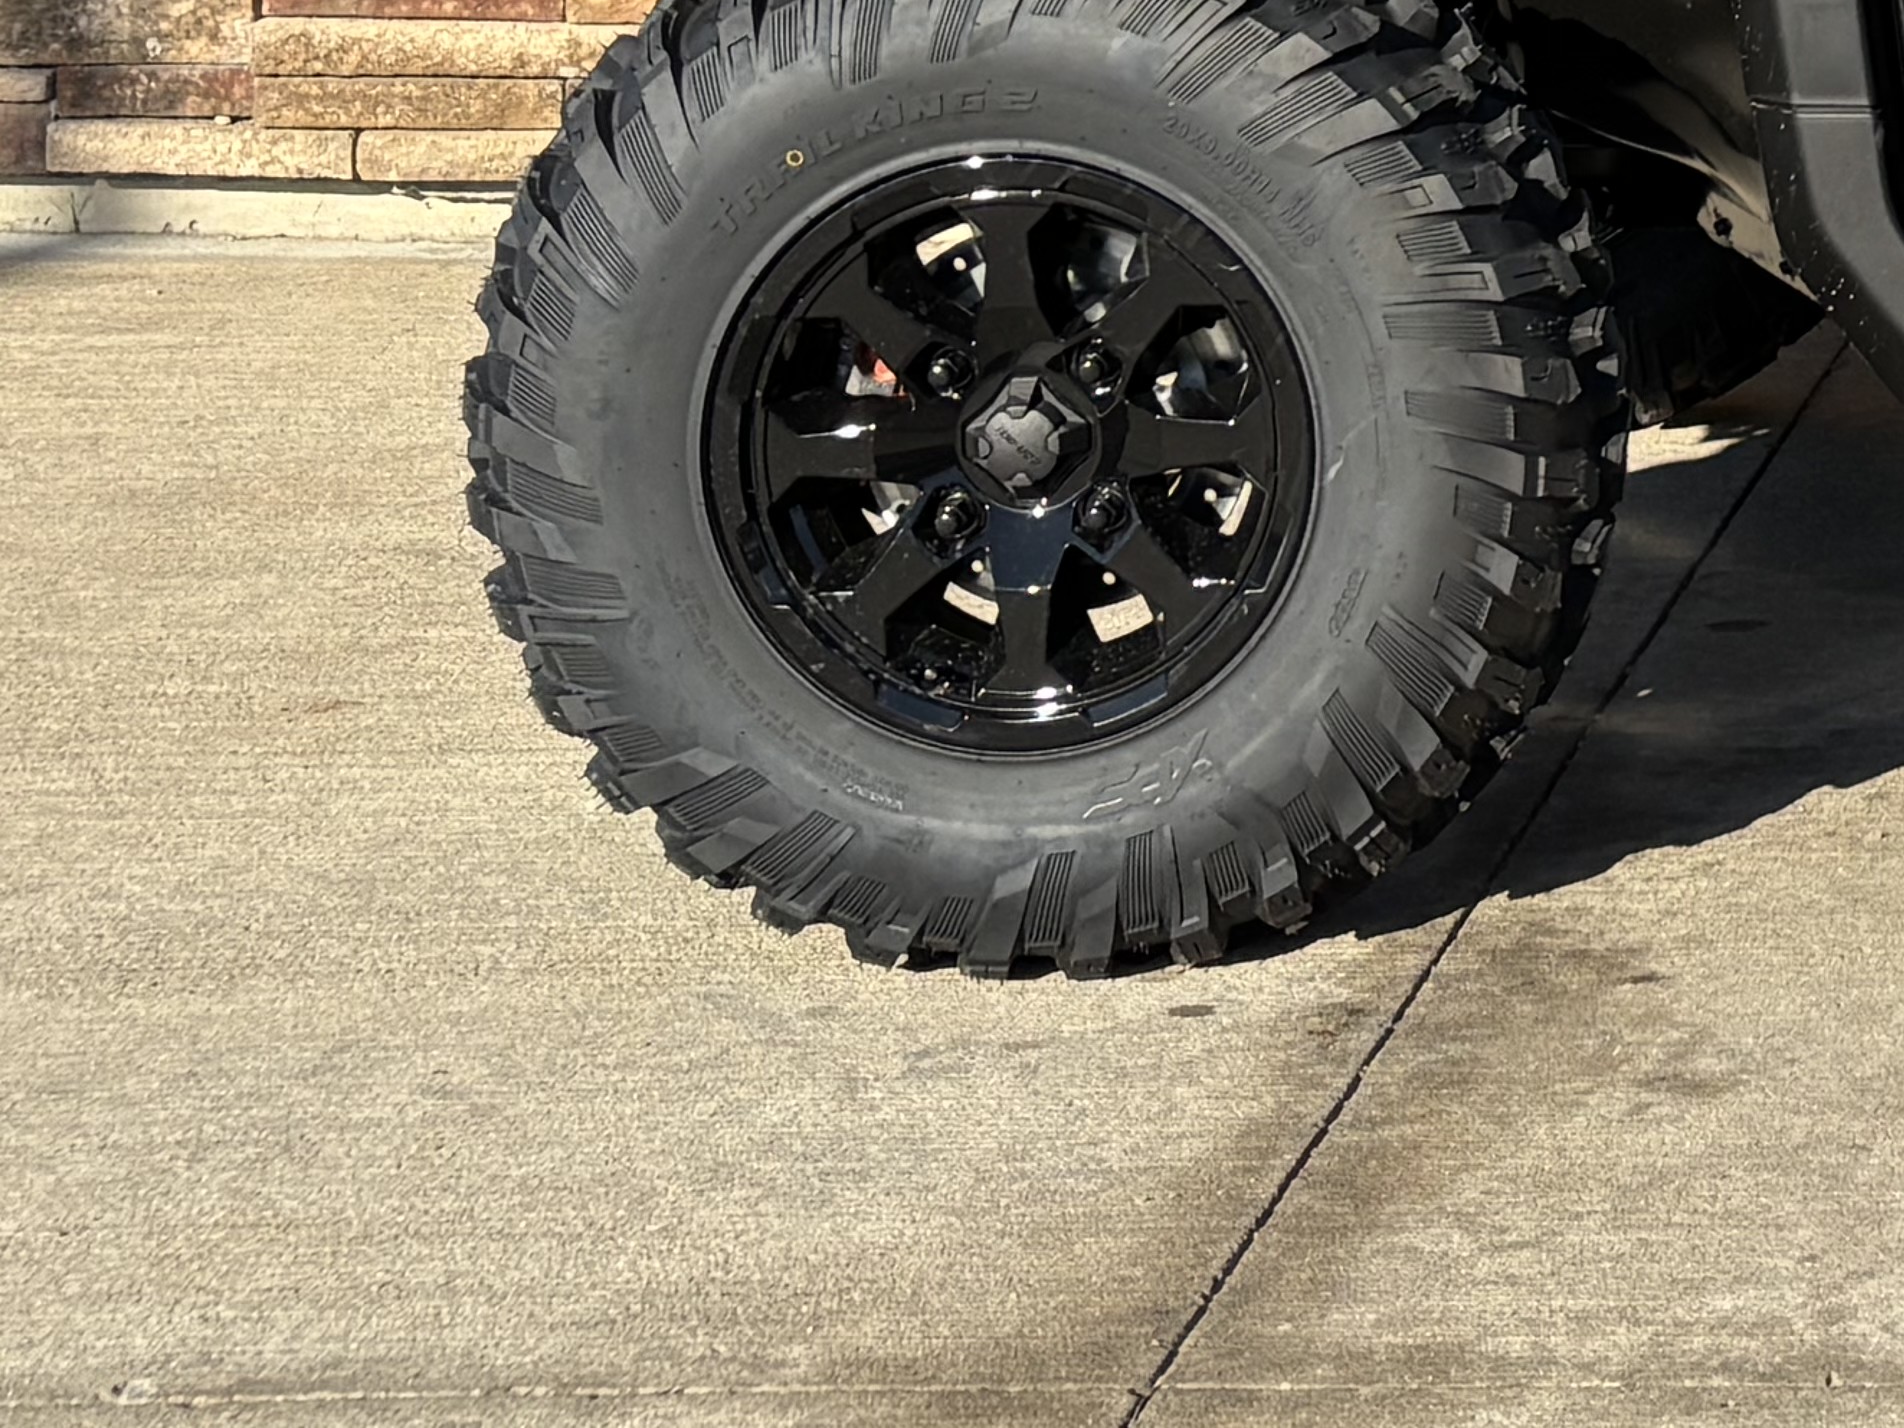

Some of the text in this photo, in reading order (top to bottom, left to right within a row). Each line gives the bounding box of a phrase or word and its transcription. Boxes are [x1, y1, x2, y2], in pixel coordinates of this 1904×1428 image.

[708, 83, 1041, 235] TRAIL KING 2
